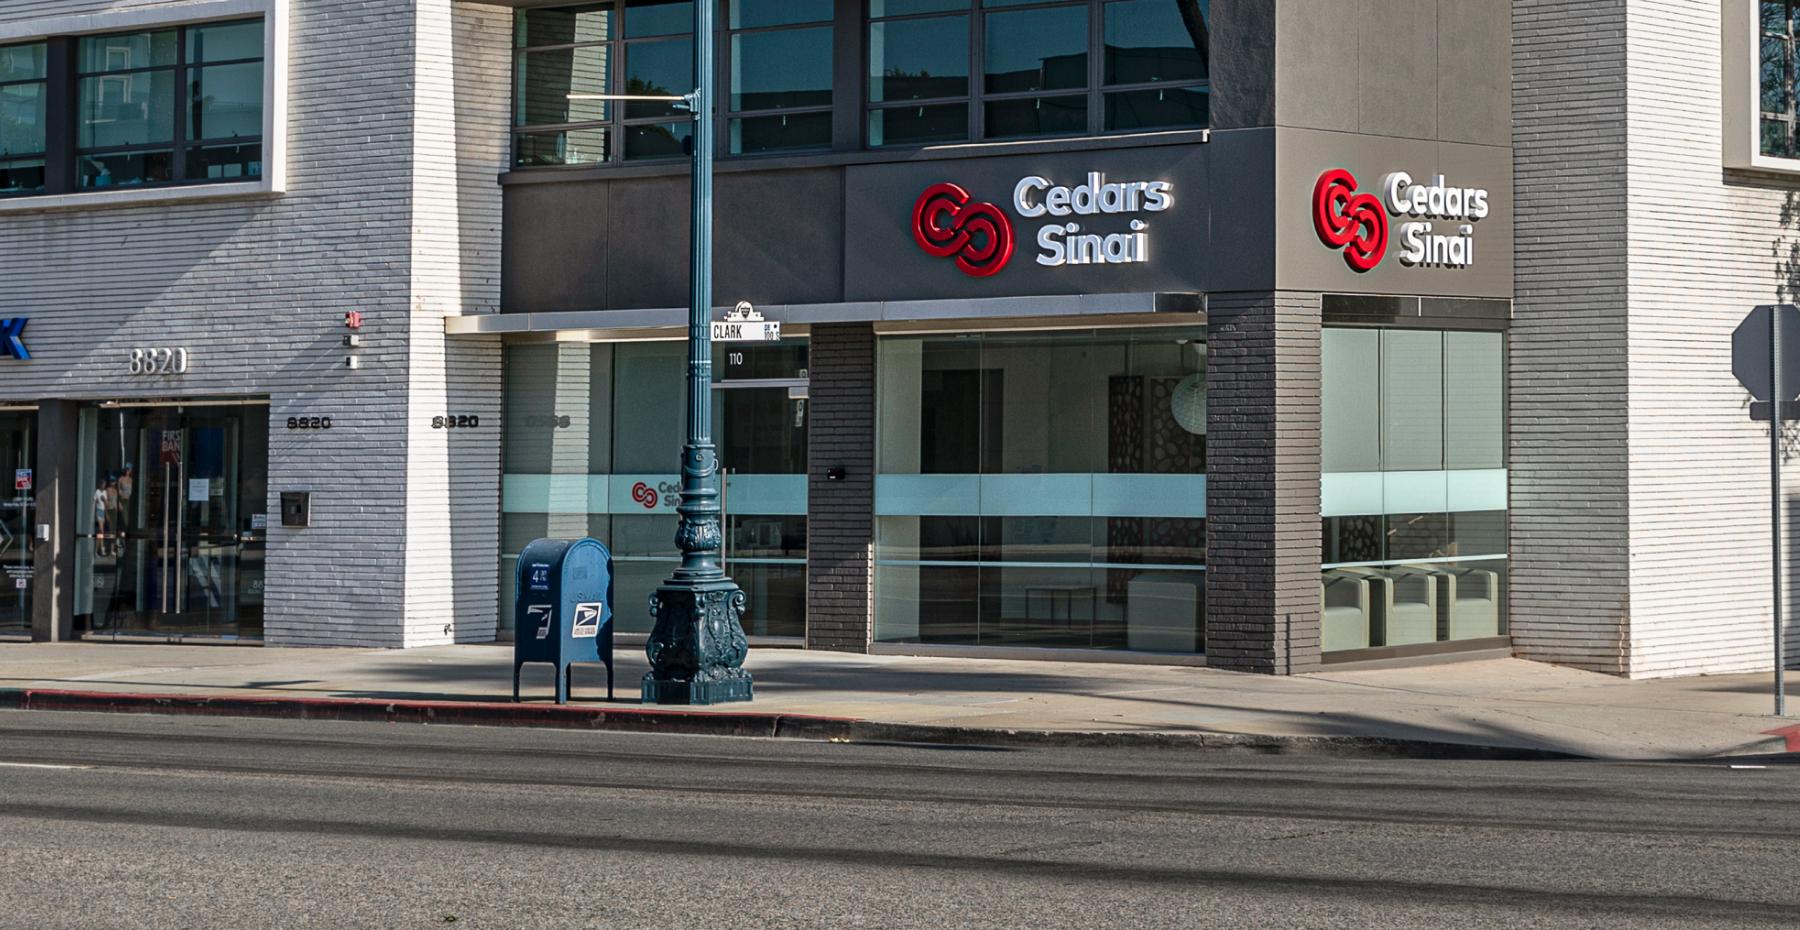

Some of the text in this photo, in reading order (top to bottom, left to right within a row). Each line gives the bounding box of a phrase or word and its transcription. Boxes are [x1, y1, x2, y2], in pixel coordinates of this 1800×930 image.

[1014, 171, 1174, 218] Cedars
[1384, 171, 1489, 220] Cedars
[1036, 219, 1149, 267] Sinai
[1400, 222, 1474, 266] Sinai
[0, 317, 32, 360] K
[714, 324, 742, 339] CLARK
[129, 347, 187, 374] 8820
[729, 352, 743, 366] 110
[287, 416, 331, 429] 8820
[431, 415, 479, 429] 8820
[162, 430, 181, 441] FIRS
[162, 441, 181, 452] BAN
[658, 480, 682, 494] Ced
[663, 494, 682, 507] Sin
